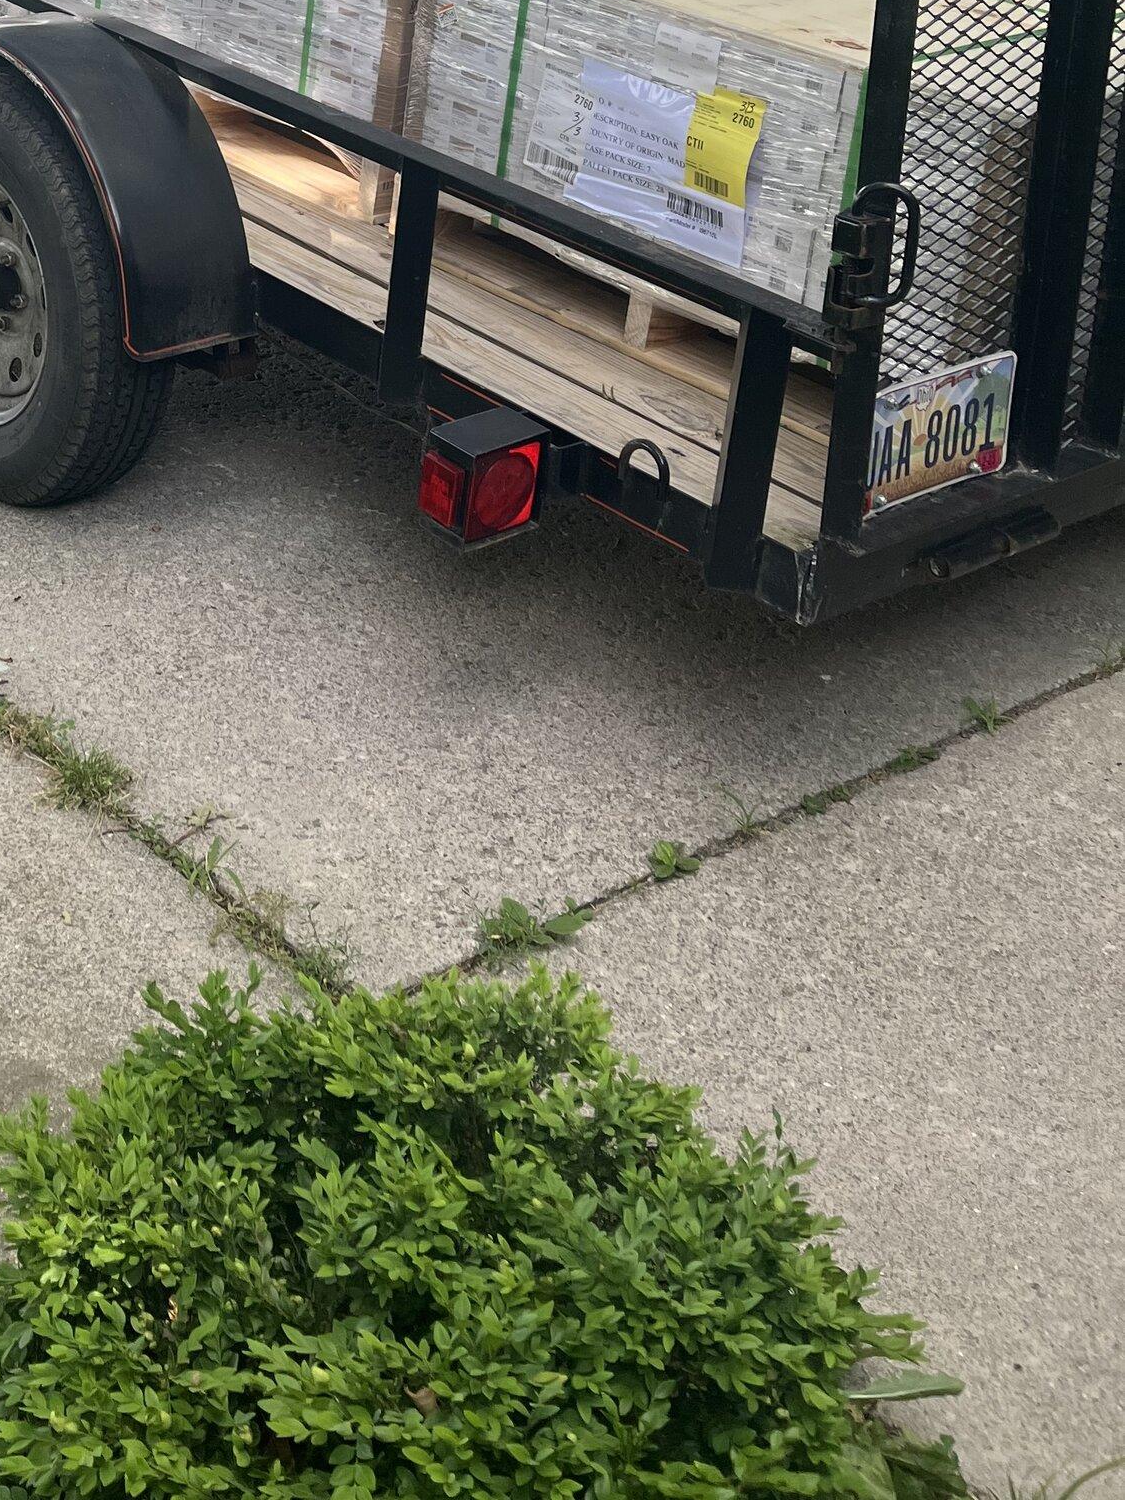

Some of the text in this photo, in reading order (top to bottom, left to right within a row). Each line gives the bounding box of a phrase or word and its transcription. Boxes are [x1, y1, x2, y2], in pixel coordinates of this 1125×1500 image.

[574, 93, 594, 111] 2760
[732, 112, 755, 129] 2760
[640, 129, 661, 143] EASY
[662, 137, 679, 150] OAK
[584, 142, 604, 156] CASE
[605, 149, 626, 165] PACK
[625, 140, 635, 150] OF
[667, 155, 686, 169] MAD
[582, 158, 611, 175] PALLET
[612, 169, 635, 184] PACK
[924, 392, 996, 469] 8081
